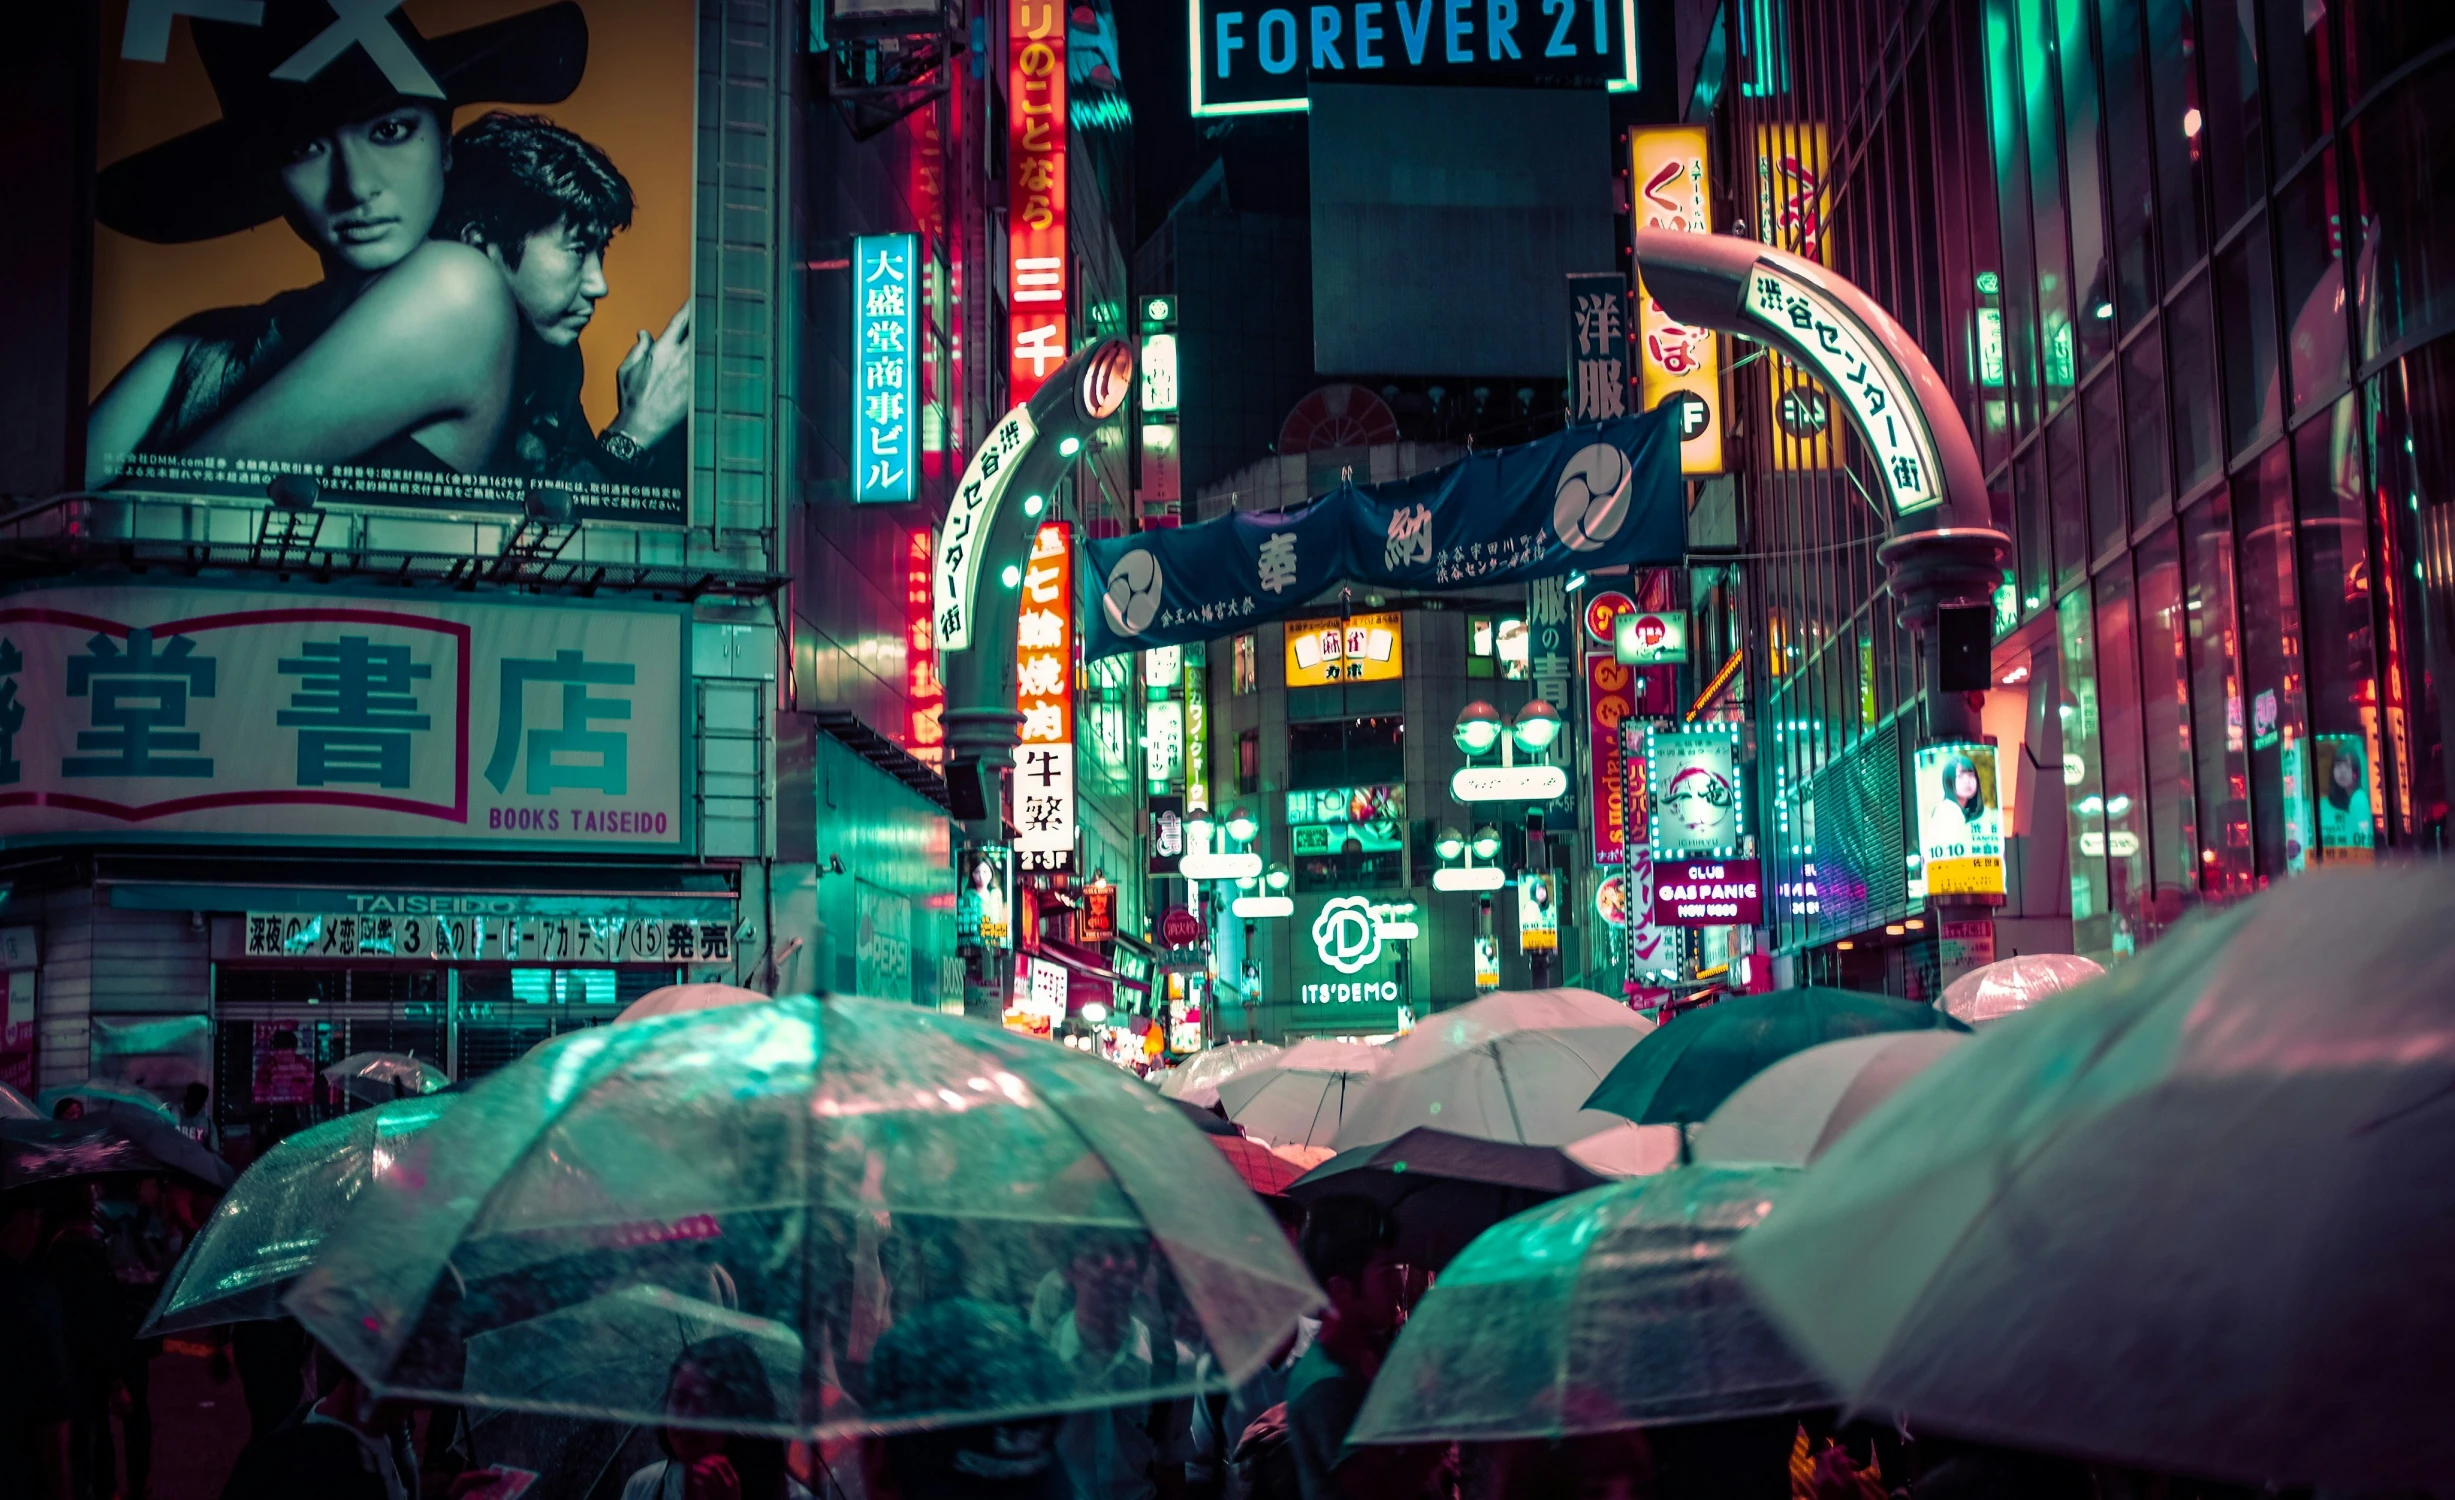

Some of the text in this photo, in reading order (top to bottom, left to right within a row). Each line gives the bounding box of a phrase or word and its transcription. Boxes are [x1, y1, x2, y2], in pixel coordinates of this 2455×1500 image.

[1216, 0, 1607, 78] FOREVER 21
[866, 250, 905, 490] 大盛堂商事ビル
[1575, 292, 1625, 420] 洋服
[1757, 276, 1922, 493] 渋谷センター街
[939, 420, 1020, 642] 渋谷センター街
[1258, 502, 1432, 594] 奉 納
[0, 628, 637, 796] 堂書店
[489, 807, 668, 836] BOOKS TAISEIDO
[1025, 751, 1063, 832] 牛繁
[346, 895, 516, 914] TAISEIDO
[1301, 981, 1398, 1005] ITS'DEMO
